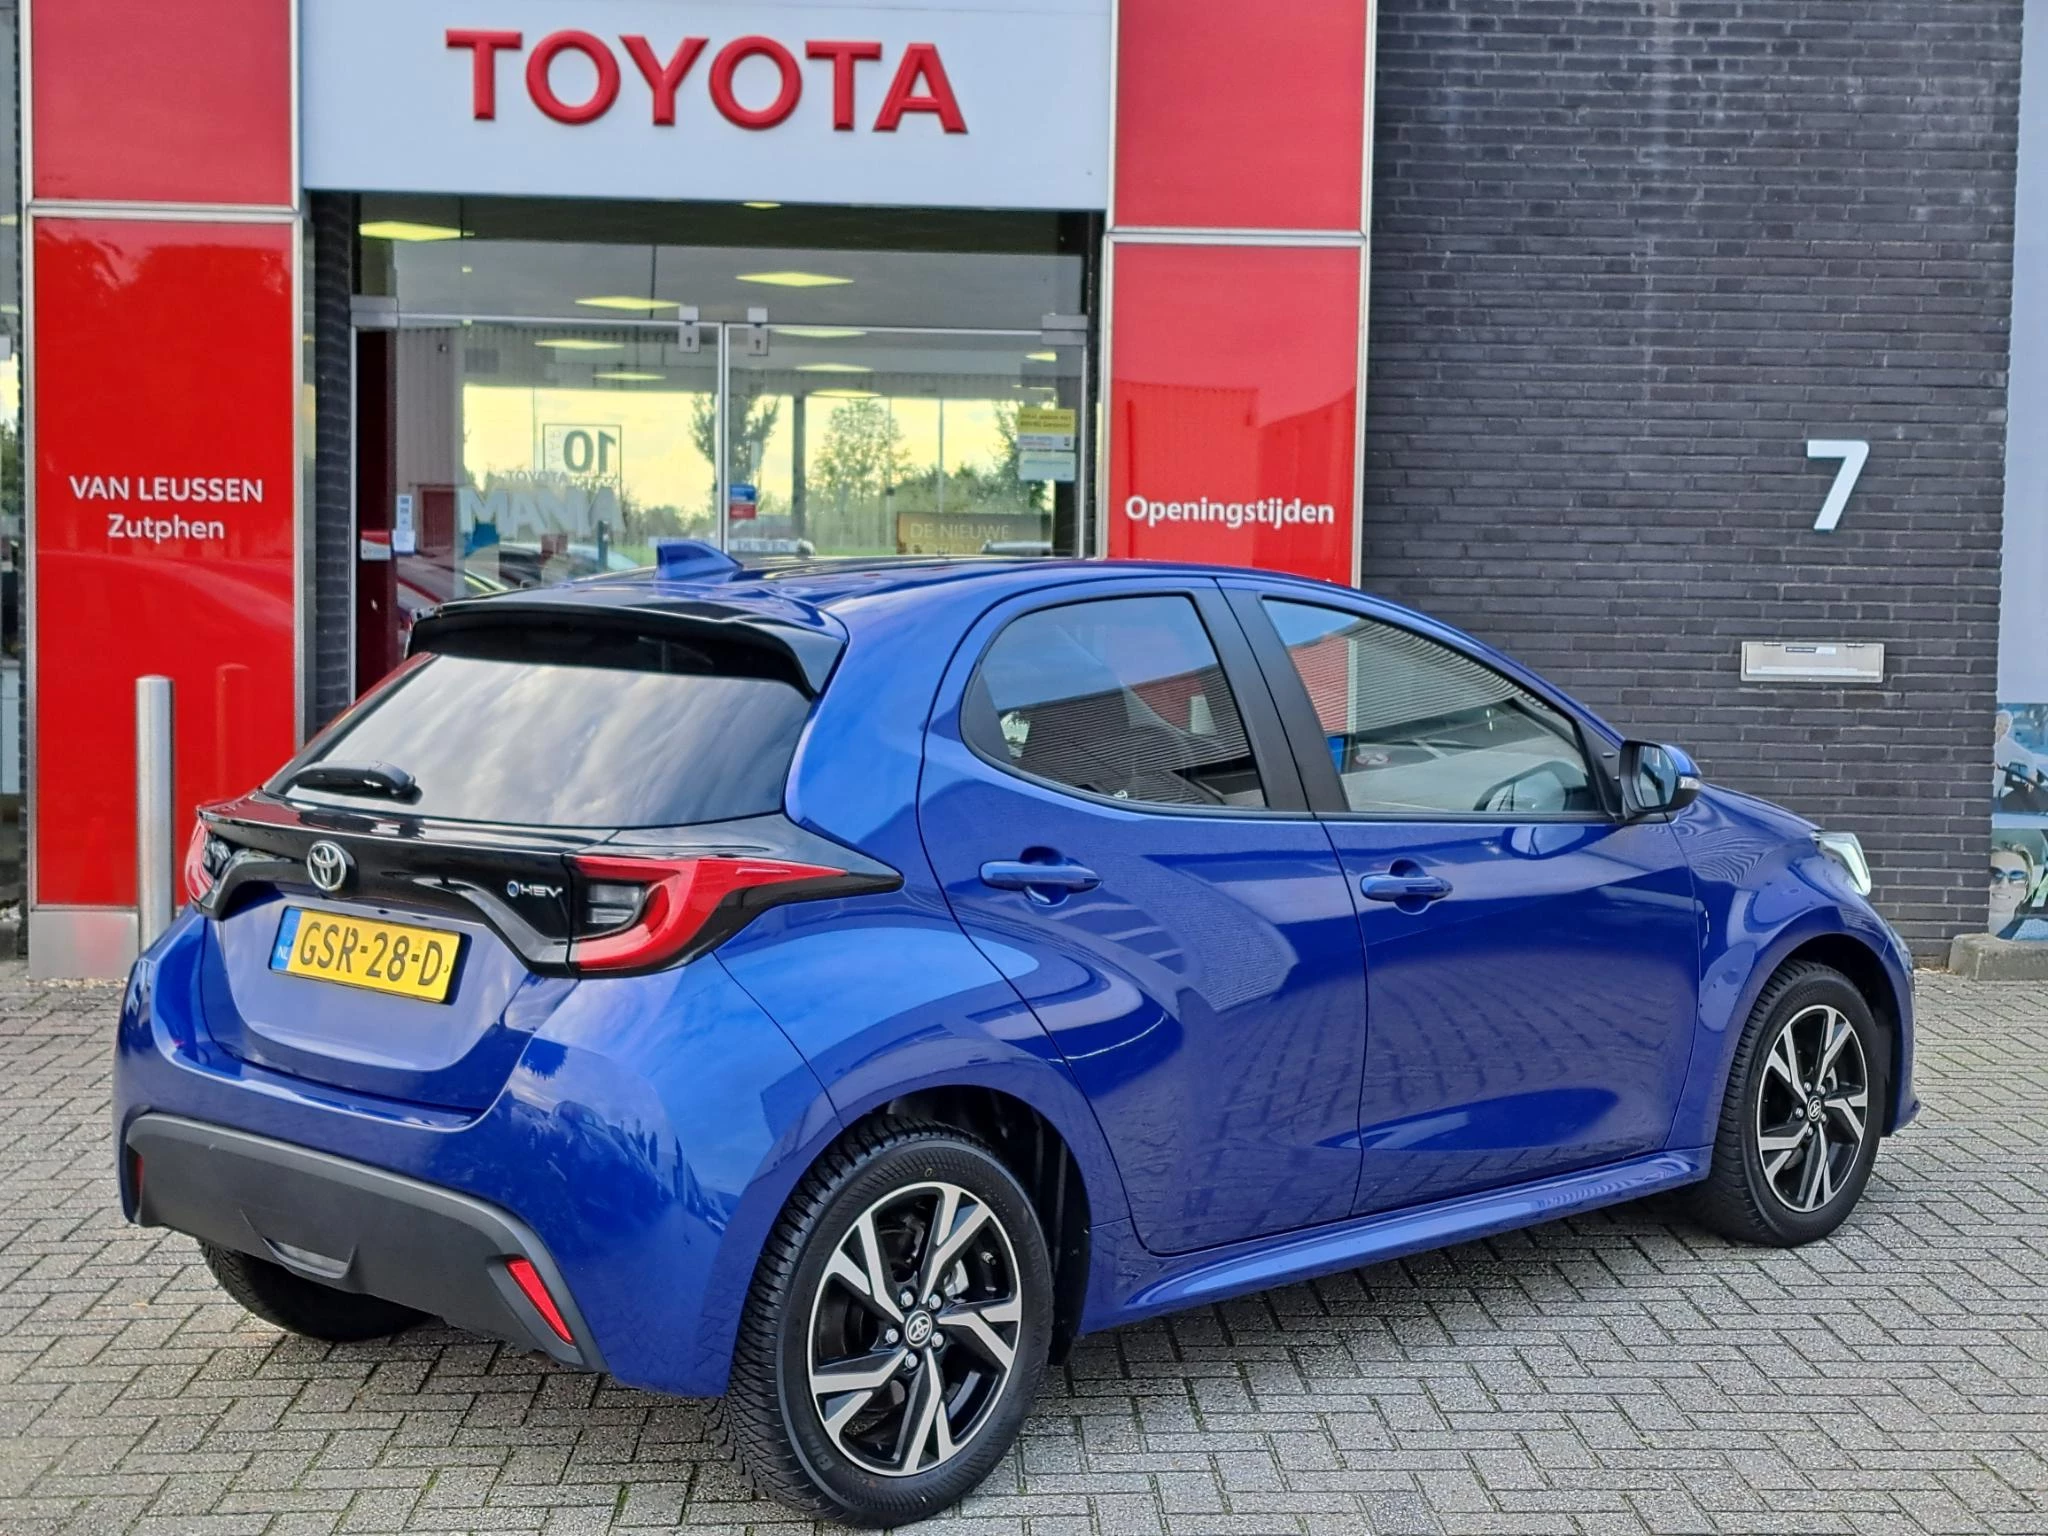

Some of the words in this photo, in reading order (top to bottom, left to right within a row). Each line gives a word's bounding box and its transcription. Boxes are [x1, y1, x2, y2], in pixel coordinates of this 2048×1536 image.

[446, 29, 968, 134] TOYOTA
[69, 475, 130, 500] VAN
[138, 477, 263, 503] LEUSSEN
[1807, 440, 1869, 530] 7
[1125, 495, 1335, 529] Openingstijden
[107, 513, 225, 544] Zutphen
[910, 523, 934, 538] DE
[939, 524, 1009, 540] NIEUWE
[520, 884, 563, 898] HEV
[299, 921, 444, 987] GSR-28-D
